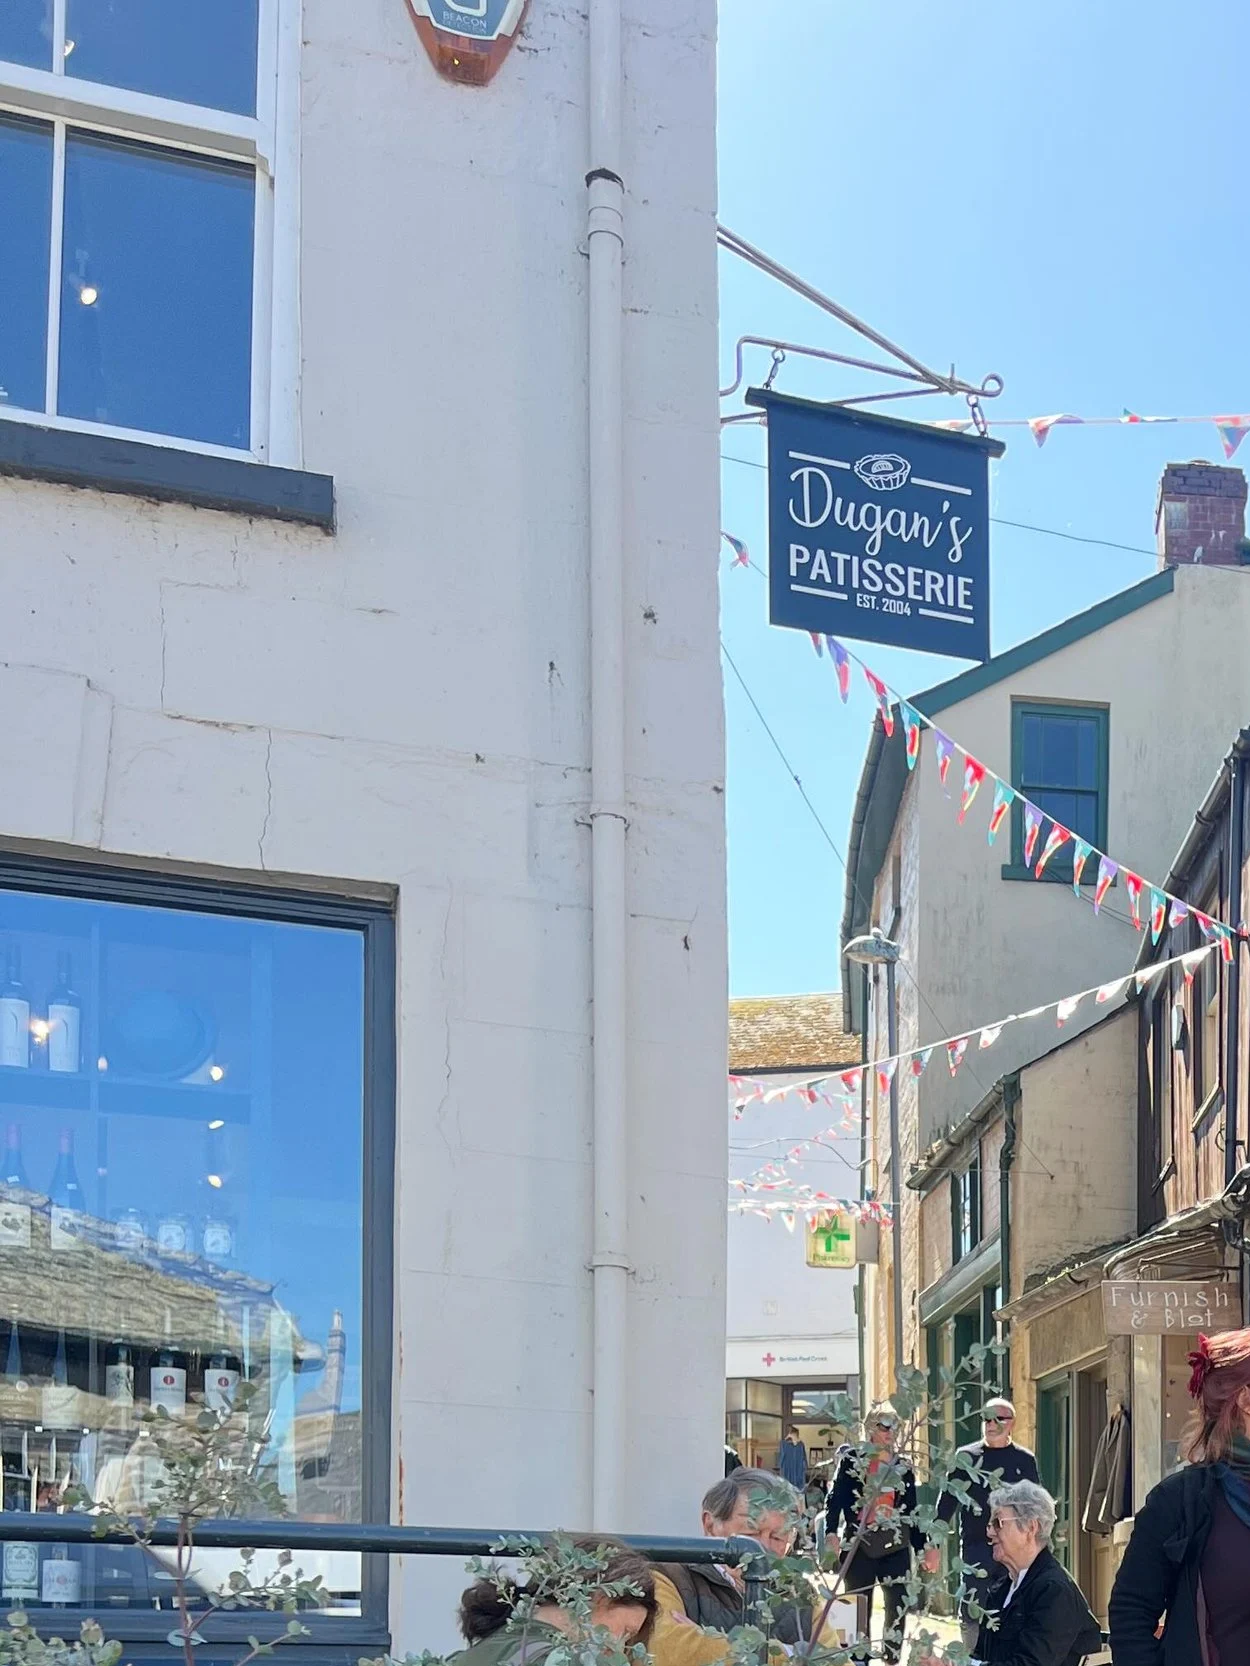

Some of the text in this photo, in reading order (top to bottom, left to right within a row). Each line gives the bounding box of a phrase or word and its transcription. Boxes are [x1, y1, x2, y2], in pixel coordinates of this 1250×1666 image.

[443, 11, 487, 29] BEACON
[788, 466, 972, 563] Dugan's
[789, 543, 974, 611] PATISSERIE
[856, 592, 912, 617] EST. 2004
[1110, 1286, 1229, 1308] Furnish
[1130, 1307, 1214, 1330] & Blot
